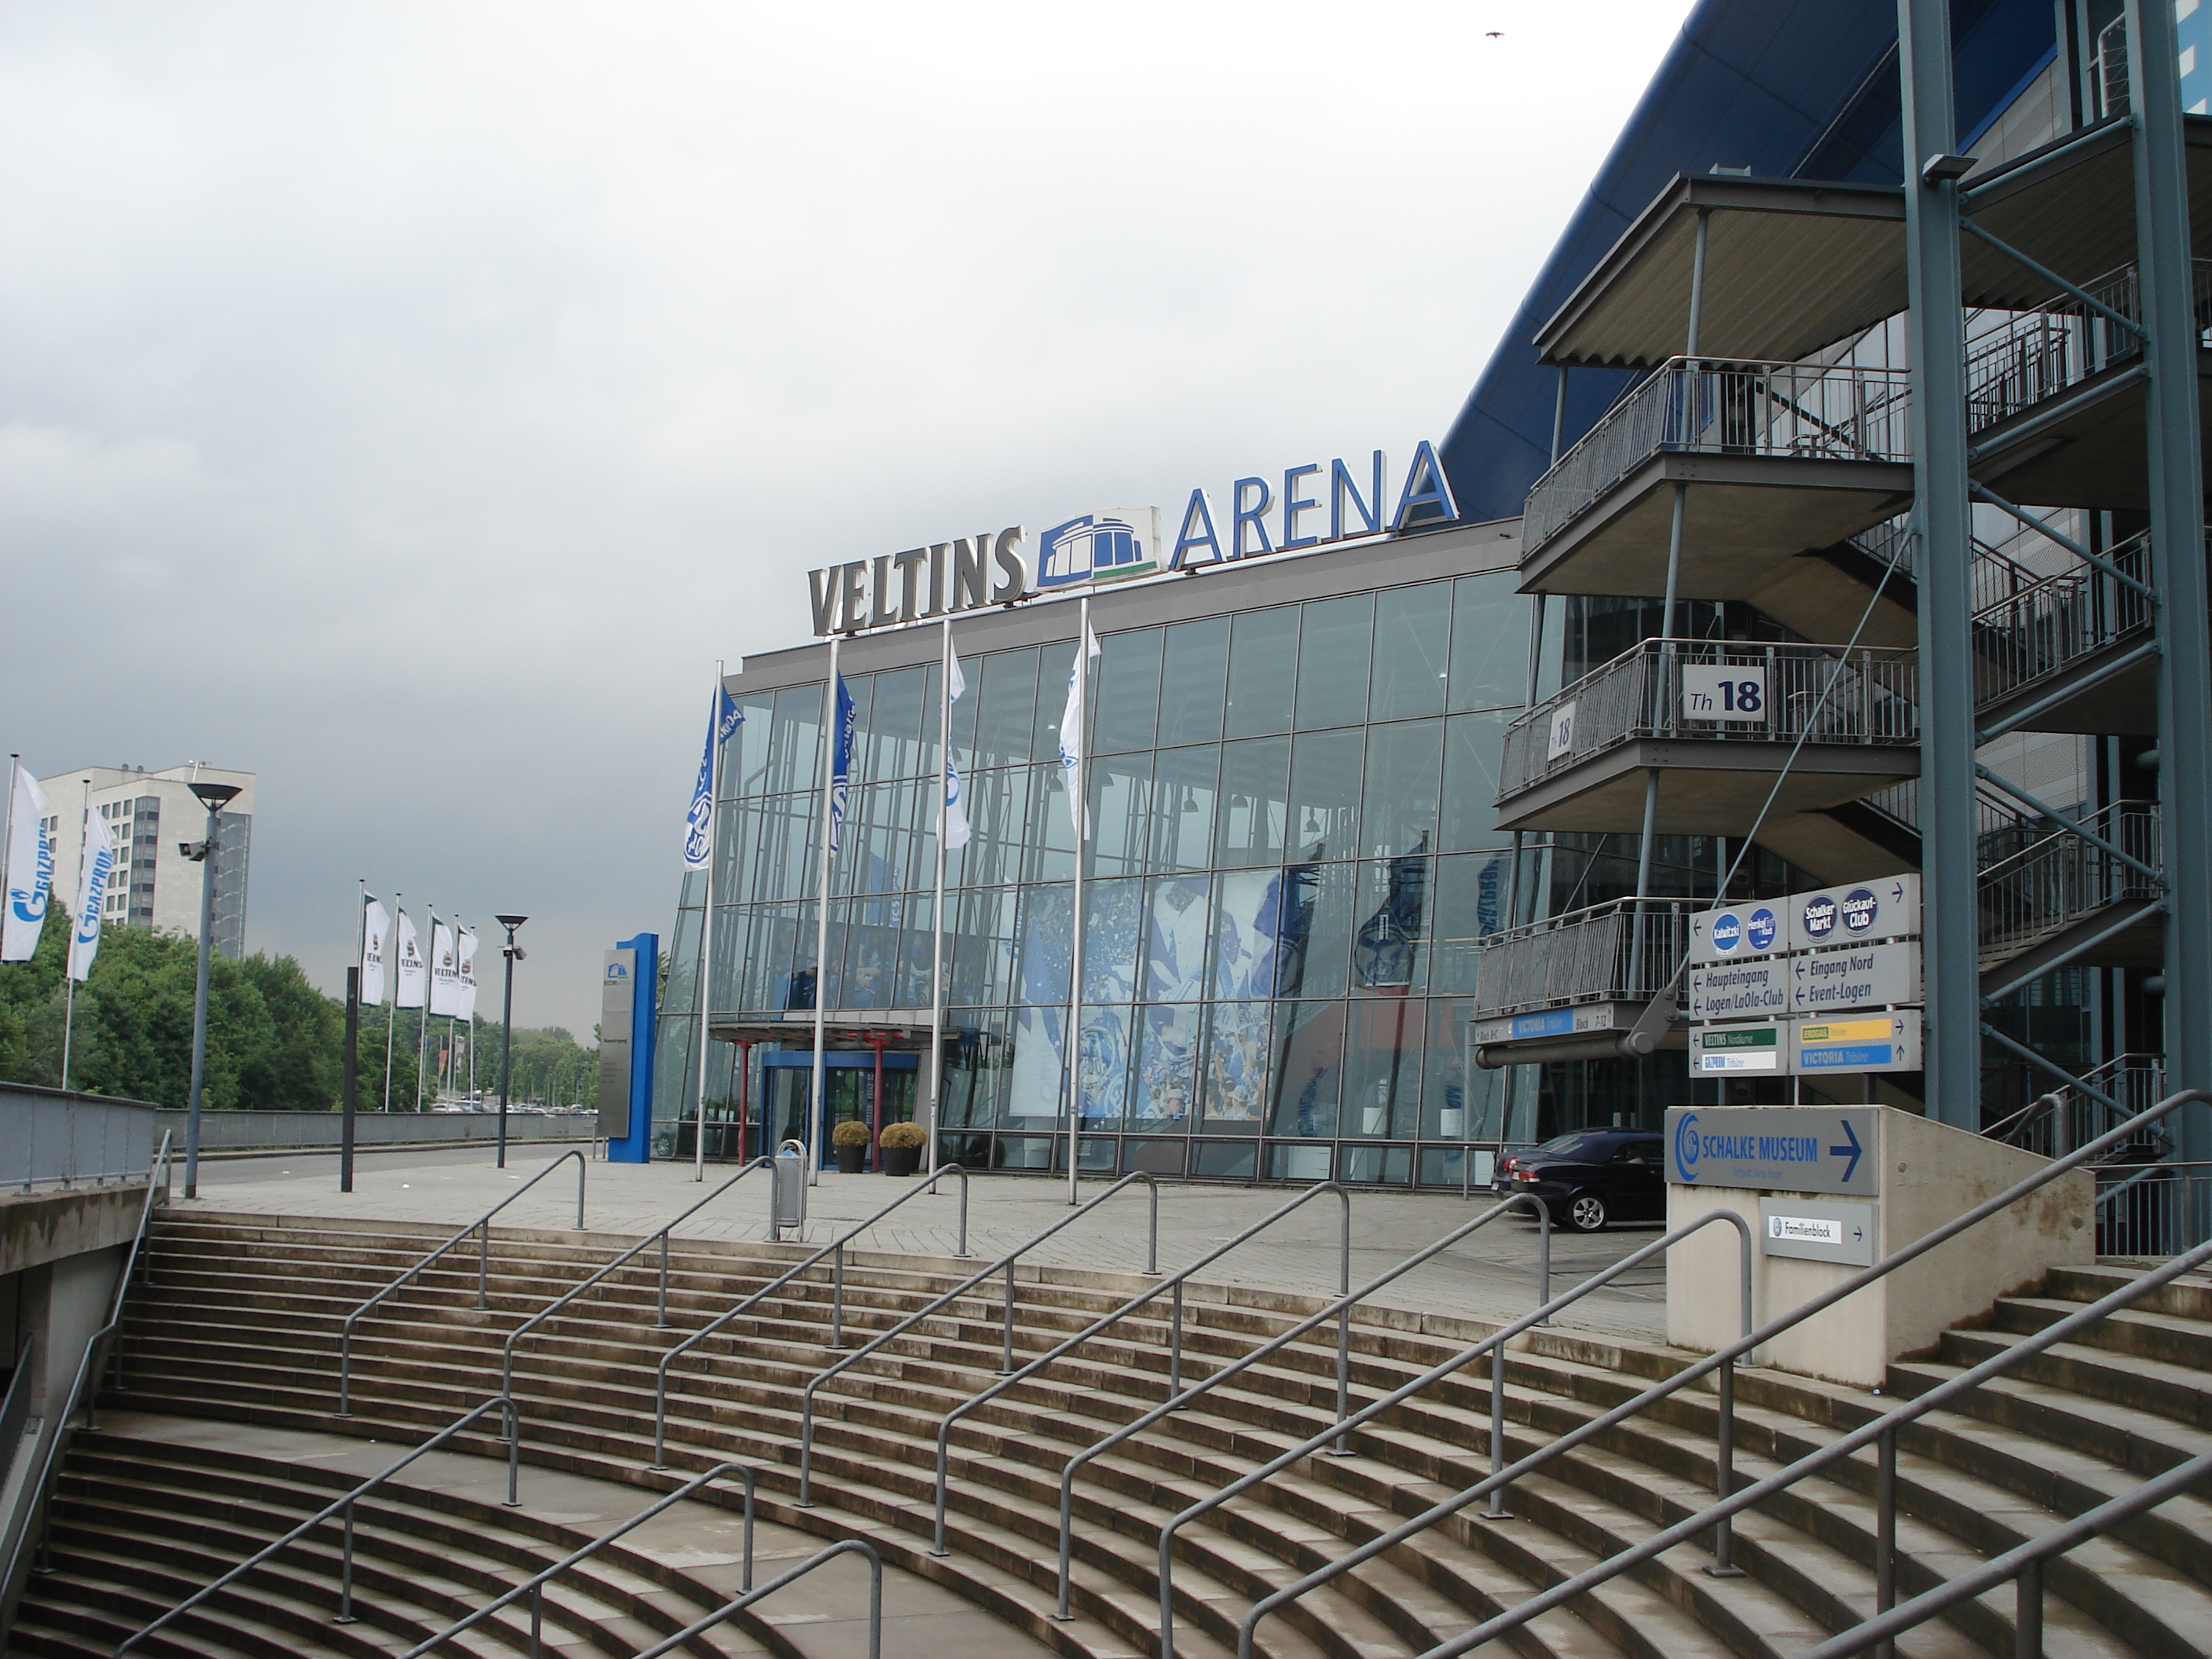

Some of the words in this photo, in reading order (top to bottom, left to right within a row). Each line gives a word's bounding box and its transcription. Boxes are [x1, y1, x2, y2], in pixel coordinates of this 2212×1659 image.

[808, 525, 1026, 637] VELTINS
[1168, 439, 1460, 571] ARENA
[1690, 694, 1712, 711] Th
[1718, 681, 1762, 712] 18
[1559, 717, 1570, 748] 18
[35, 821, 52, 892] GAZPRO
[1806, 904, 1835, 920] Schalker
[1843, 896, 1877, 914] Glückauf-
[1810, 915, 1831, 932] Markt
[1850, 911, 1869, 928] Club
[1811, 956, 1847, 979] Eingang
[1850, 953, 1873, 972] Nord
[1706, 969, 1768, 991] Haupteingang
[1706, 988, 1784, 1014] Logen/LaOla-Club
[1809, 983, 1871, 1004] Event-Logen
[1576, 1017, 1588, 1031] Block
[1705, 1034, 1727, 1046] VELTINS
[1728, 1035, 1753, 1046] Nordkurve
[1804, 1051, 1844, 1065] VICTORIA
[1703, 1136, 1755, 1159] SCHALKE
[1759, 1137, 1818, 1162] MUSEUM
[1785, 1221, 1831, 1238] Familienblock
